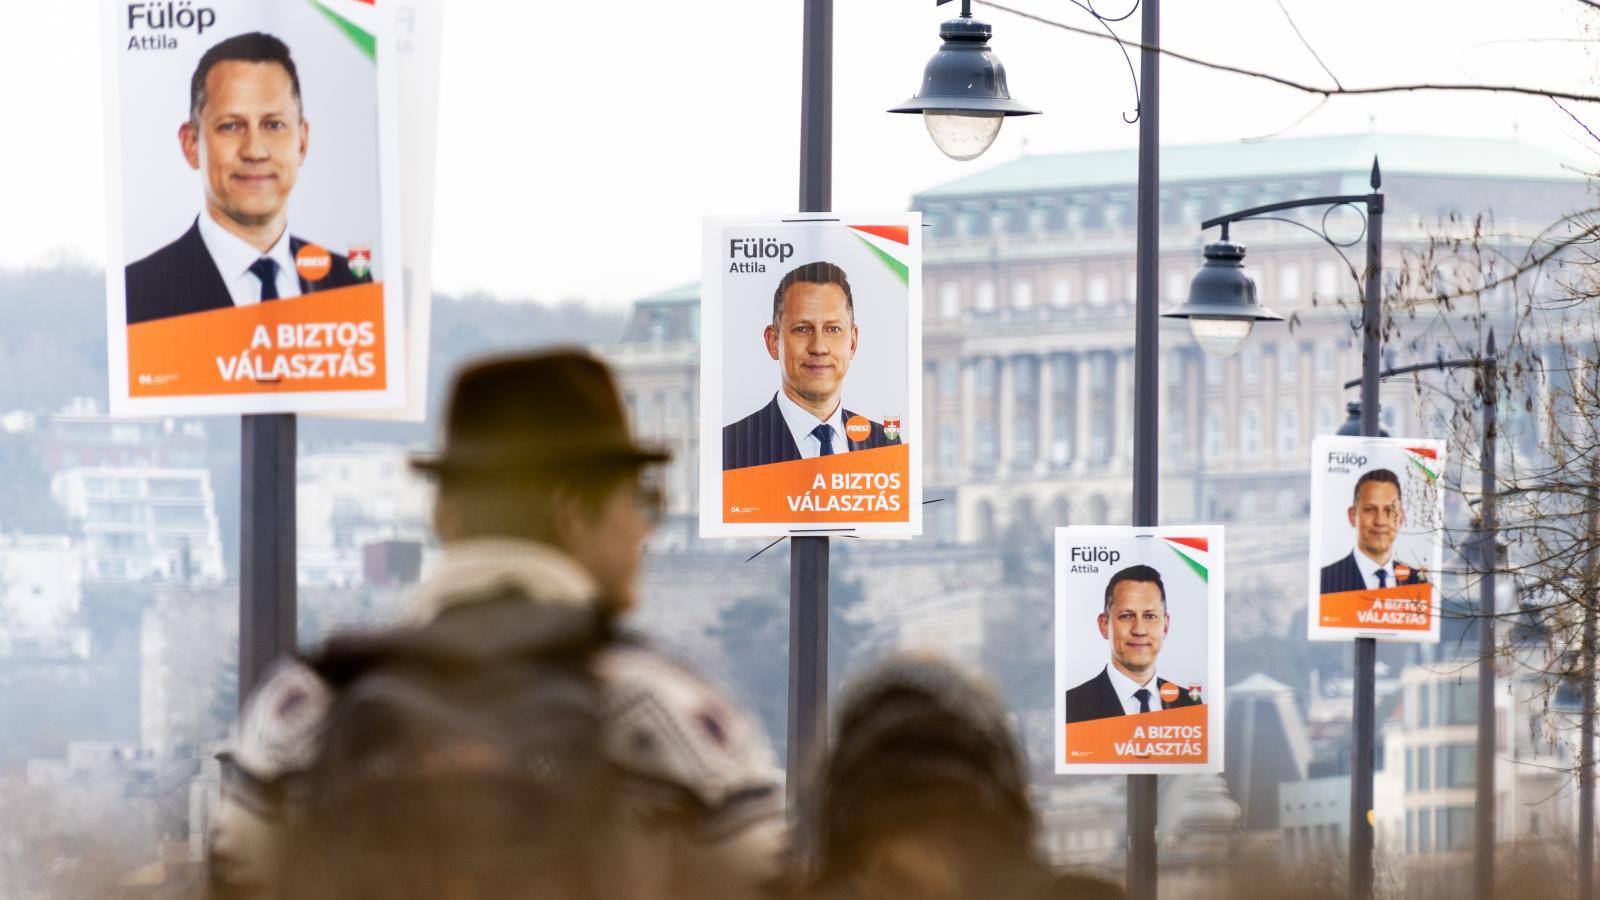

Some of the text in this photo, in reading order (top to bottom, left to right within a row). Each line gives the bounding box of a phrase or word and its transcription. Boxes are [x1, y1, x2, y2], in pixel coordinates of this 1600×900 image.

[127, 1, 216, 34] Fülöp
[128, 35, 178, 50] Attila
[730, 238, 794, 262] Fülöp
[729, 262, 766, 273] Attila
[251, 321, 375, 349] A BIZTOS
[216, 348, 376, 381] VÁLASZTÁS
[812, 473, 901, 489] A BIZTOS
[787, 491, 901, 511] VÁLASZTÁS
[1071, 546, 1120, 565] Fülöp
[1071, 564, 1099, 573] Attila
[1372, 598, 1383, 610] A
[1133, 726, 1202, 739] A BIZTOS
[1114, 740, 1202, 756] VÁLASZTÁS
